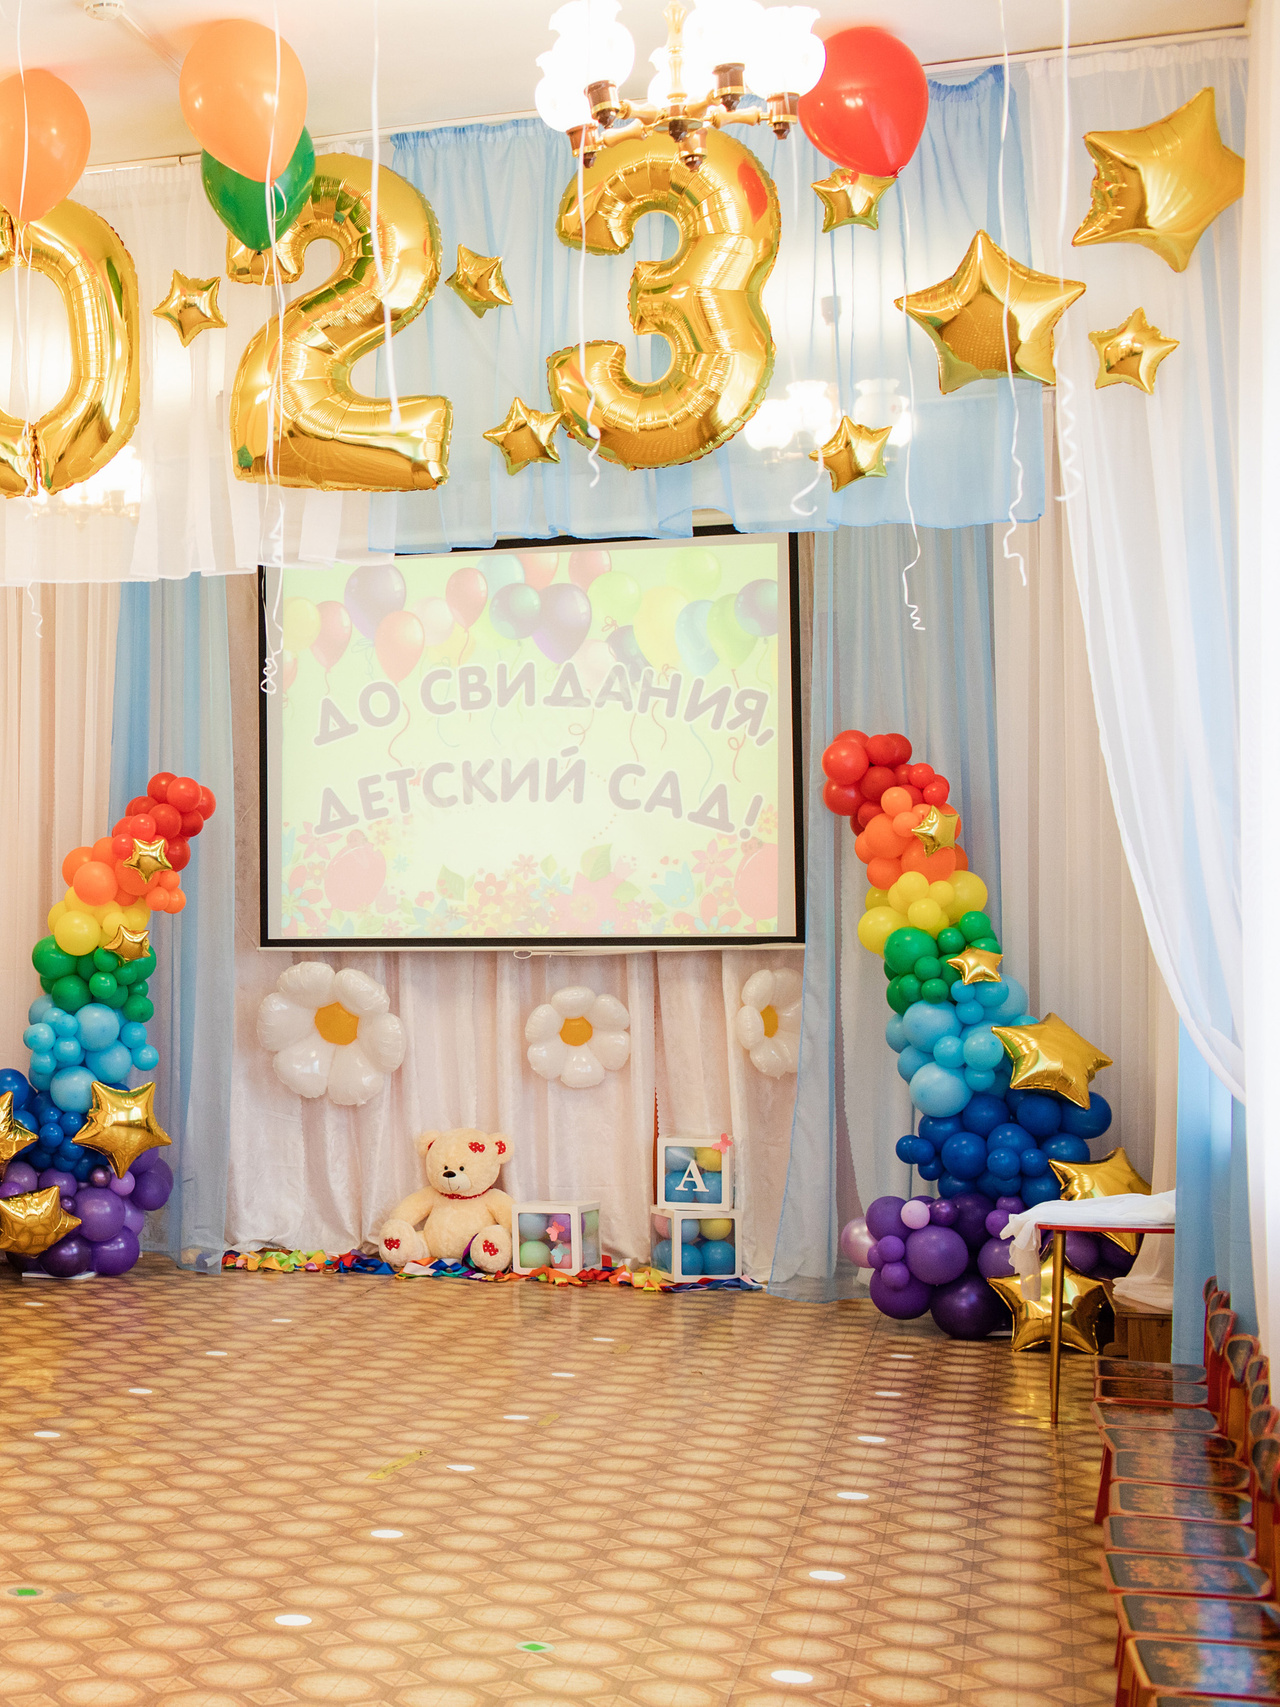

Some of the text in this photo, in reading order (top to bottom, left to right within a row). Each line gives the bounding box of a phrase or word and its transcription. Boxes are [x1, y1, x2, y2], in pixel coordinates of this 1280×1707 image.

[315, 662, 775, 747] ДО СВИДАНИЯ,
[315, 746, 764, 840] ДЕТСКИЙ САД!
